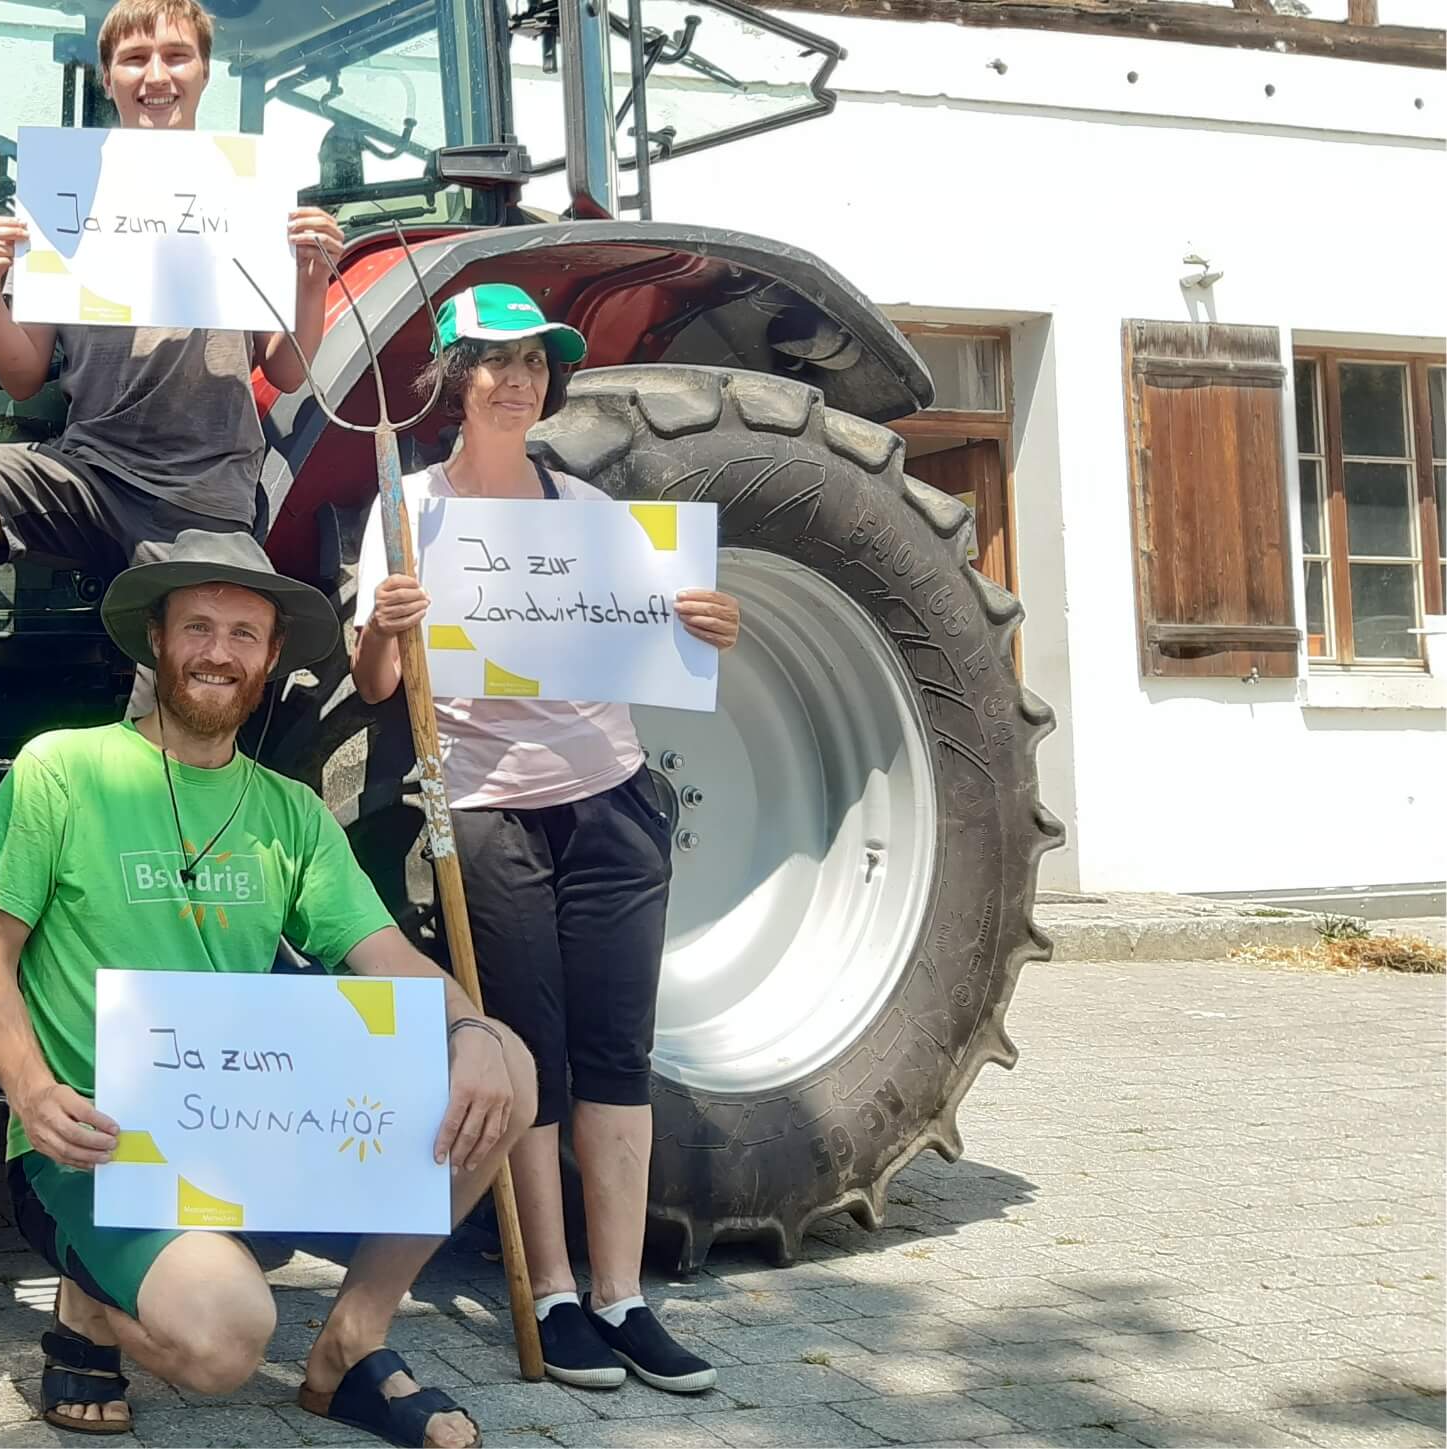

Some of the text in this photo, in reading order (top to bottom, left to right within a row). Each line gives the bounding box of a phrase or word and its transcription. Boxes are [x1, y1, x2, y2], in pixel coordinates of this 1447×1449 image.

[57, 192, 229, 235] Ja zum Zivi
[457, 537, 578, 575] Ja zur
[463, 585, 671, 625] Landwirtschaft
[149, 1028, 295, 1073] Ja zum
[176, 1094, 395, 1136] SUNNAHOF
